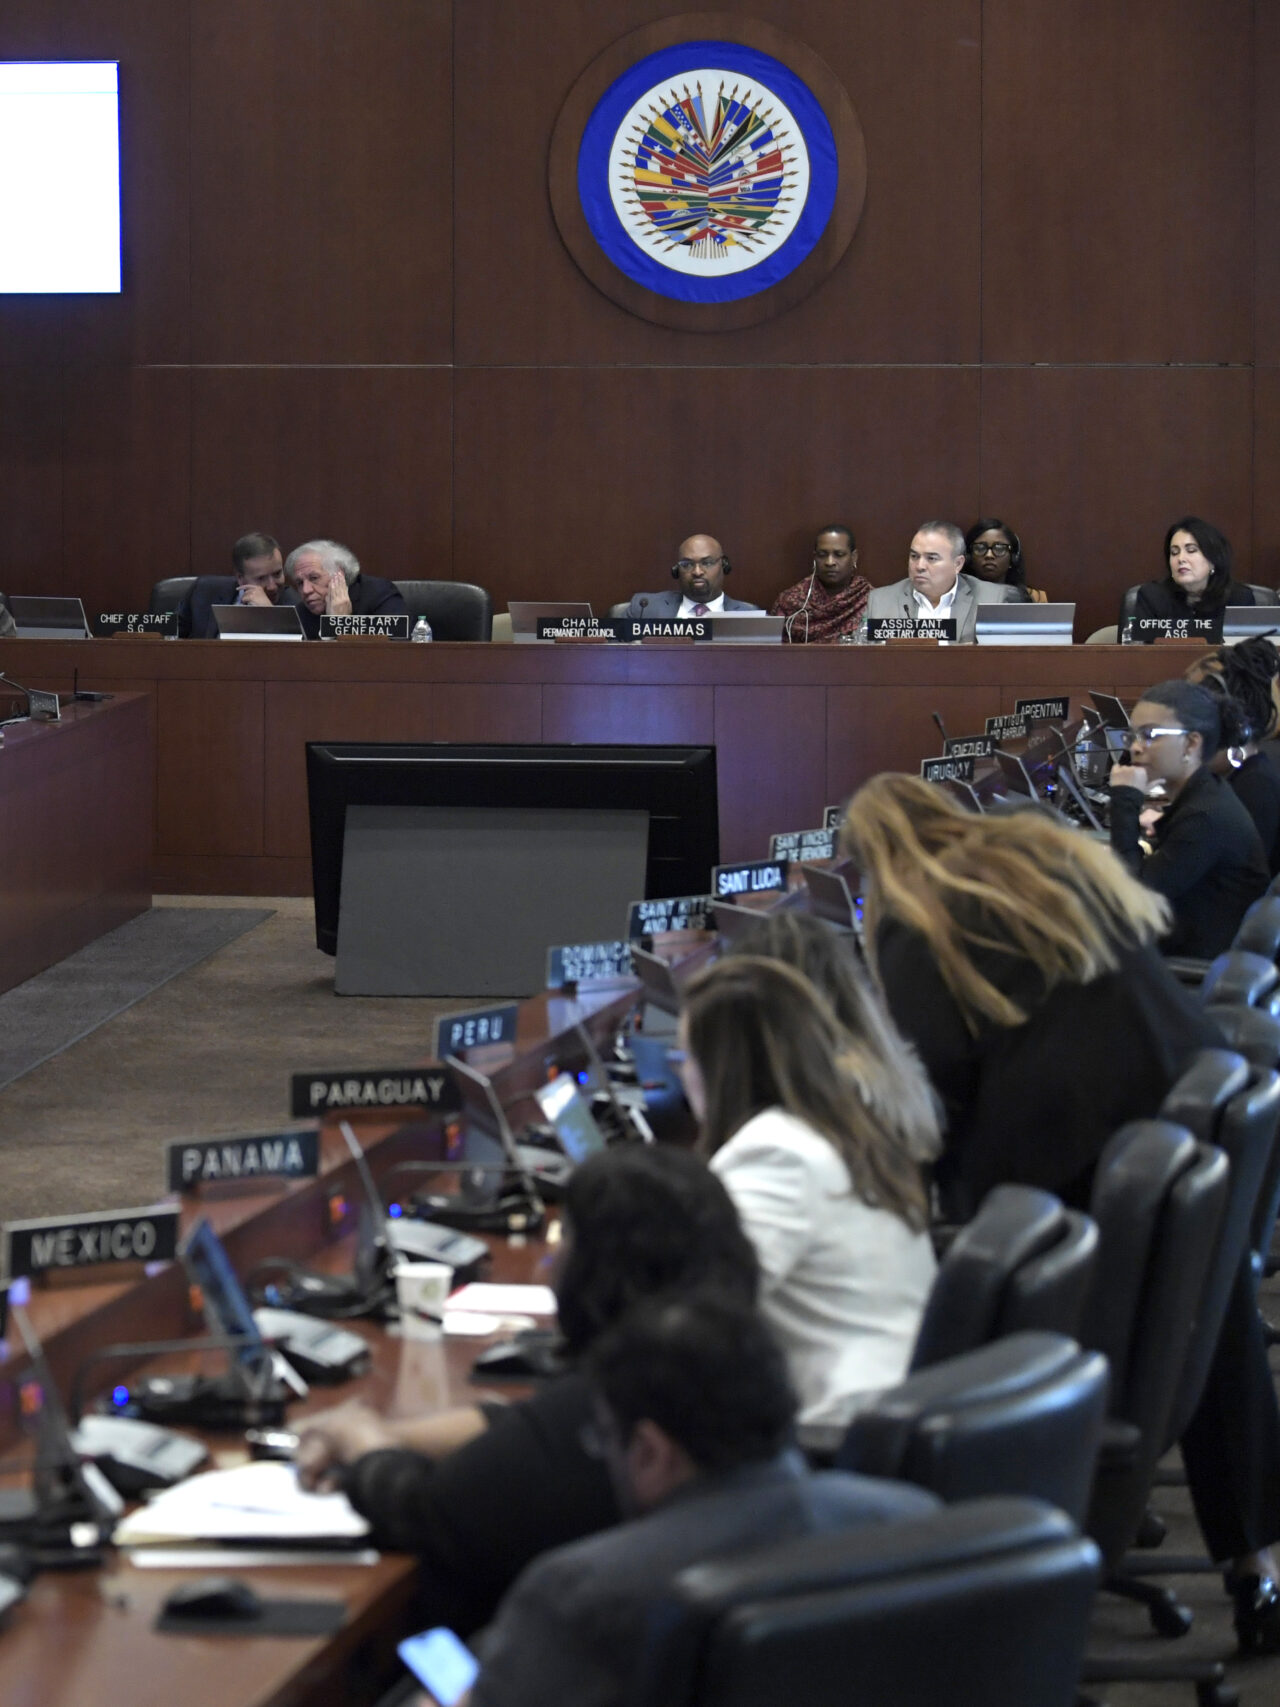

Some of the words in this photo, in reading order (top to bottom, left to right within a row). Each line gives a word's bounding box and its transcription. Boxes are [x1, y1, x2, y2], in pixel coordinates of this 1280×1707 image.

[100, 614, 124, 623] CHIEF
[127, 614, 139, 624] OF
[143, 614, 172, 624] STAFF
[329, 617, 399, 626] SECRETARY
[562, 618, 599, 628] CHAIR
[881, 619, 942, 629] ASSISTANT
[1140, 619, 1172, 629] OFFICE
[1176, 619, 1189, 629] OF
[1194, 619, 1213, 629] THE
[334, 626, 393, 636] GENERAL
[542, 627, 584, 638] PERMANENT
[587, 627, 616, 638] COUNCIL
[632, 623, 705, 636] BAHAMAS
[874, 629, 915, 639] SECRETARY
[917, 629, 950, 639] GENERAL
[1164, 629, 1188, 639] ASG
[1020, 702, 1064, 719] ARGENTINA
[993, 714, 1025, 728] ANTIGUA
[1001, 726, 1027, 740] BARBUDA
[751, 866, 782, 891] LUCIA
[638, 900, 674, 920] SAINT
[641, 917, 668, 935] AND
[561, 942, 632, 964] DOMINICA
[451, 1015, 503, 1047] PERU
[309, 1076, 445, 1107] PARAGUAY
[182, 1140, 304, 1181] PANAMA
[30, 1220, 157, 1267] MEXICO
